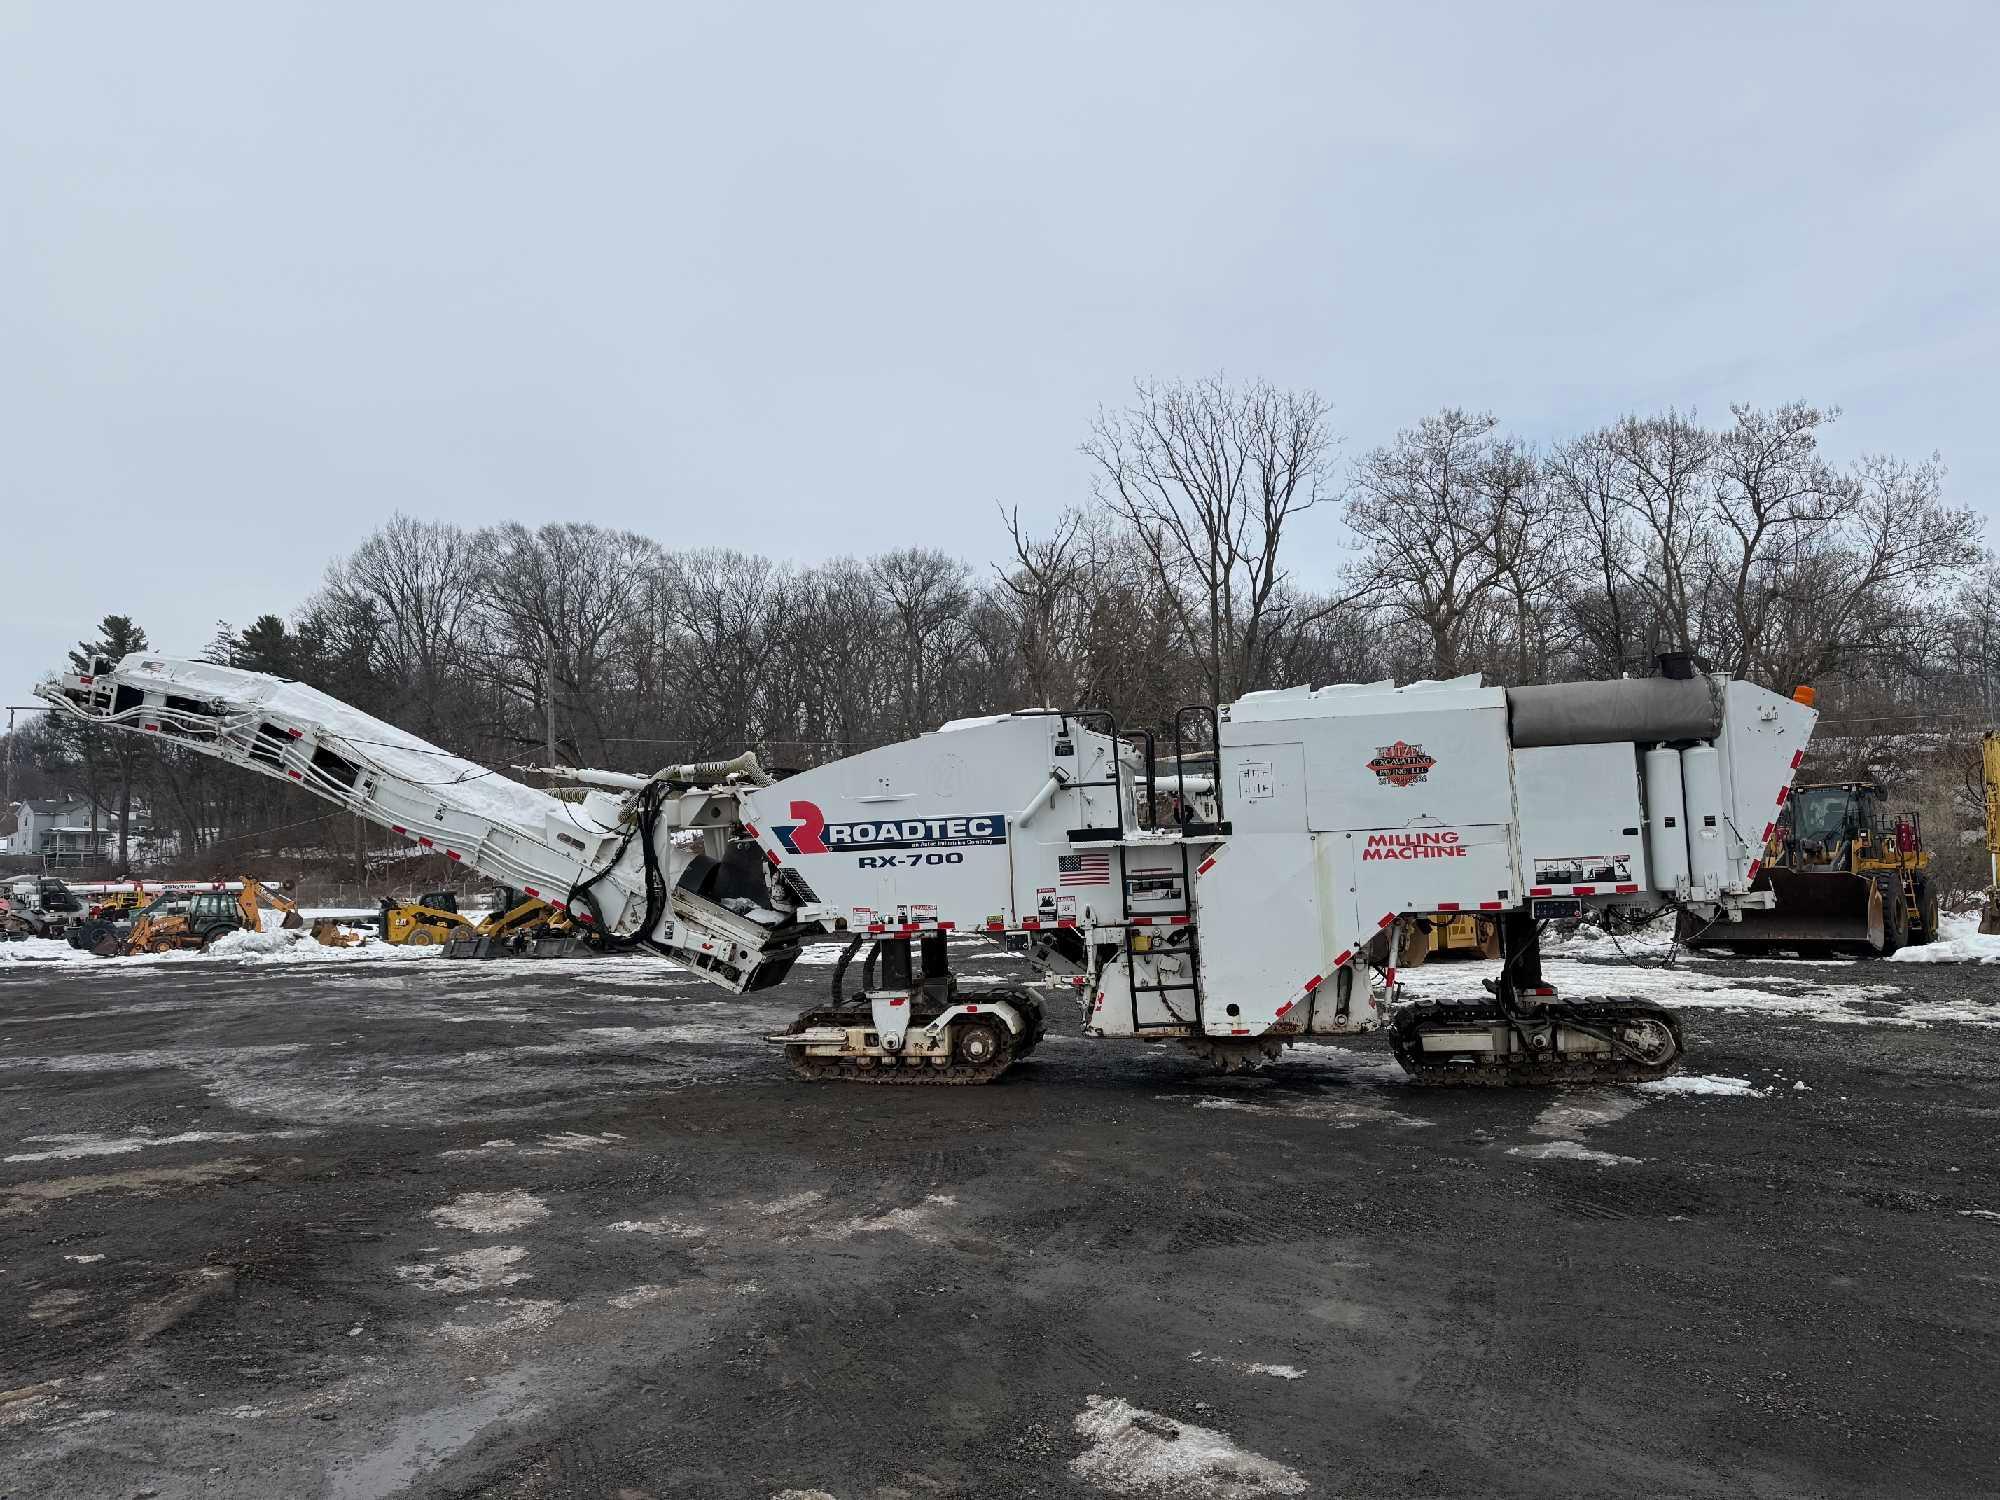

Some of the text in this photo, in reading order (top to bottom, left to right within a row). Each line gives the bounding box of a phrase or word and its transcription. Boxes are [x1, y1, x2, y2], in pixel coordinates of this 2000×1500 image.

[1373, 756, 1431, 766] EXCAVATING
[829, 818, 993, 843] ROADTEC
[1367, 832, 1459, 848] MILLING
[859, 853, 964, 869] RX-700
[1362, 846, 1467, 861] MACHINE
